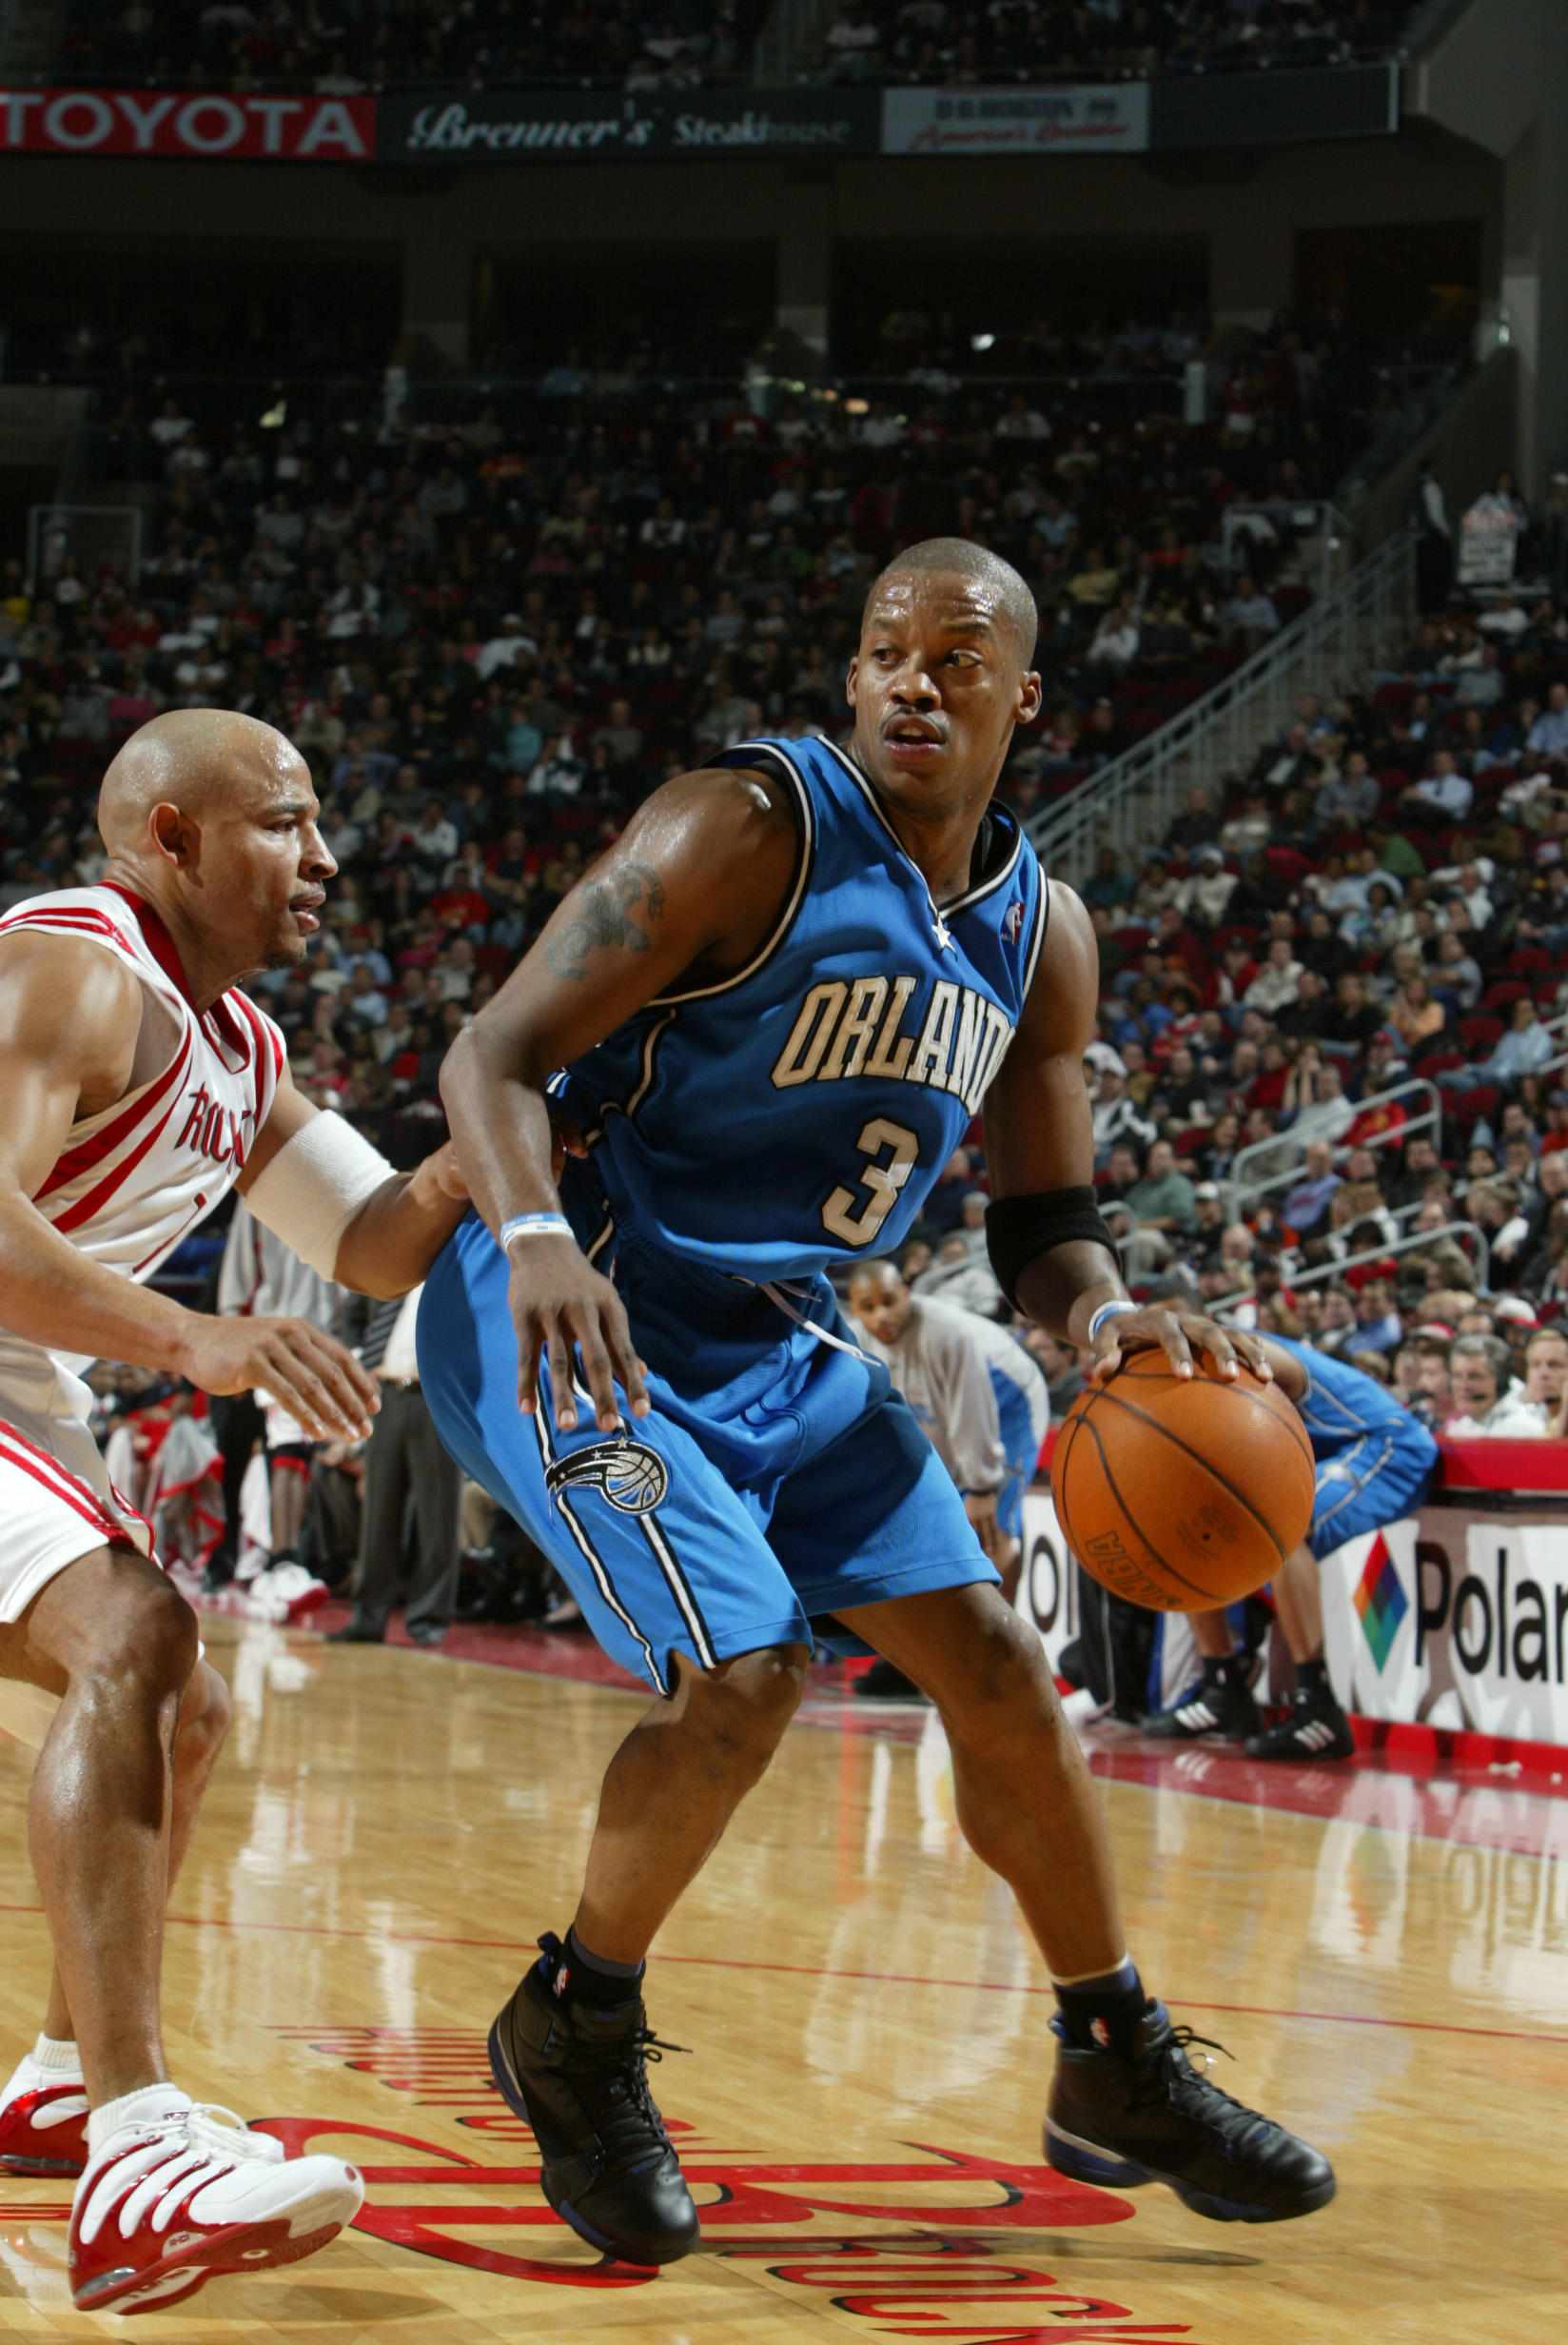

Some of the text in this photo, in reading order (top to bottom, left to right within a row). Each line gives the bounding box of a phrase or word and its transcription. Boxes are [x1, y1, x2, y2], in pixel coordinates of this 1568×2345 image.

[0, 91, 366, 156] TOYOTA
[405, 99, 851, 151] Brenner's Steakhouse
[771, 975, 1015, 1116] ORLAND
[820, 1114, 921, 1248] 3
[1415, 1541, 1568, 1684] Polar
